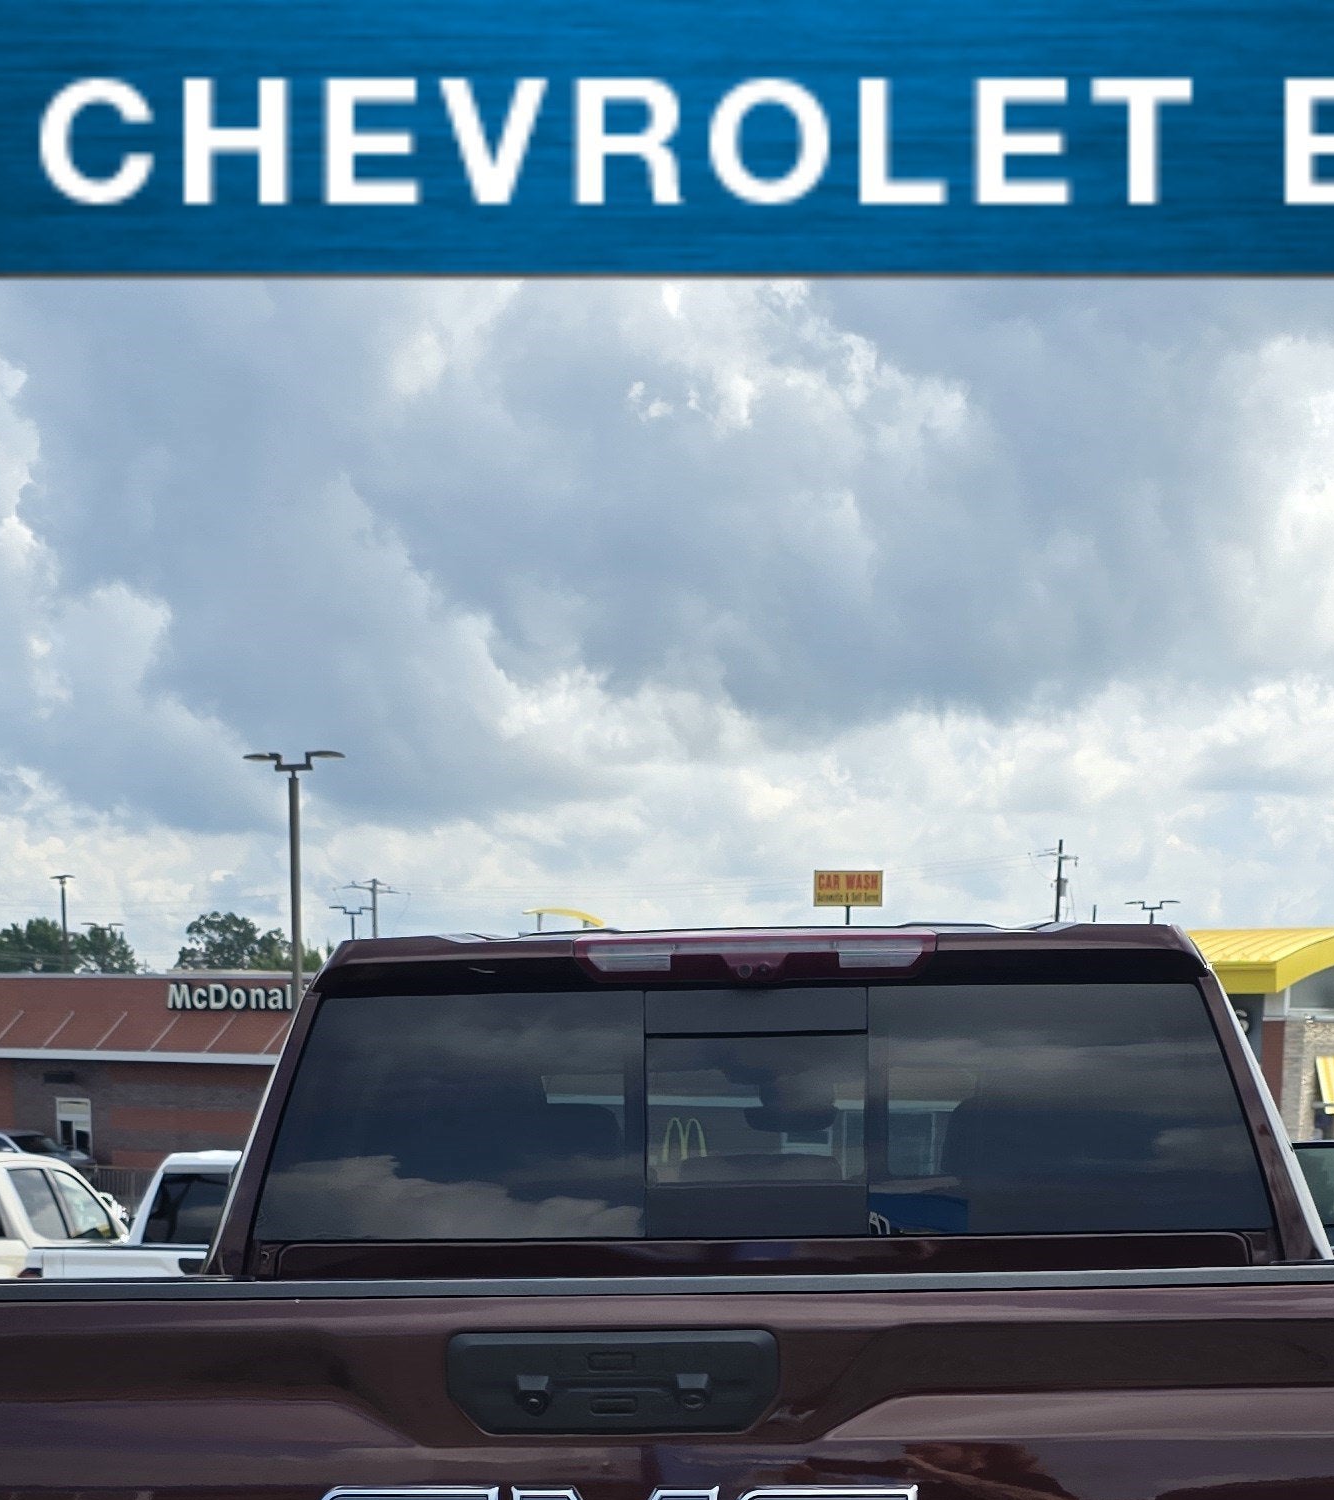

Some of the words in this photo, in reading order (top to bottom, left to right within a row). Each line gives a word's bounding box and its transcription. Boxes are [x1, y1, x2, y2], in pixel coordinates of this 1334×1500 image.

[818, 874, 839, 890] CAR
[846, 874, 879, 890] WASH
[167, 983, 293, 1010] McDonal
